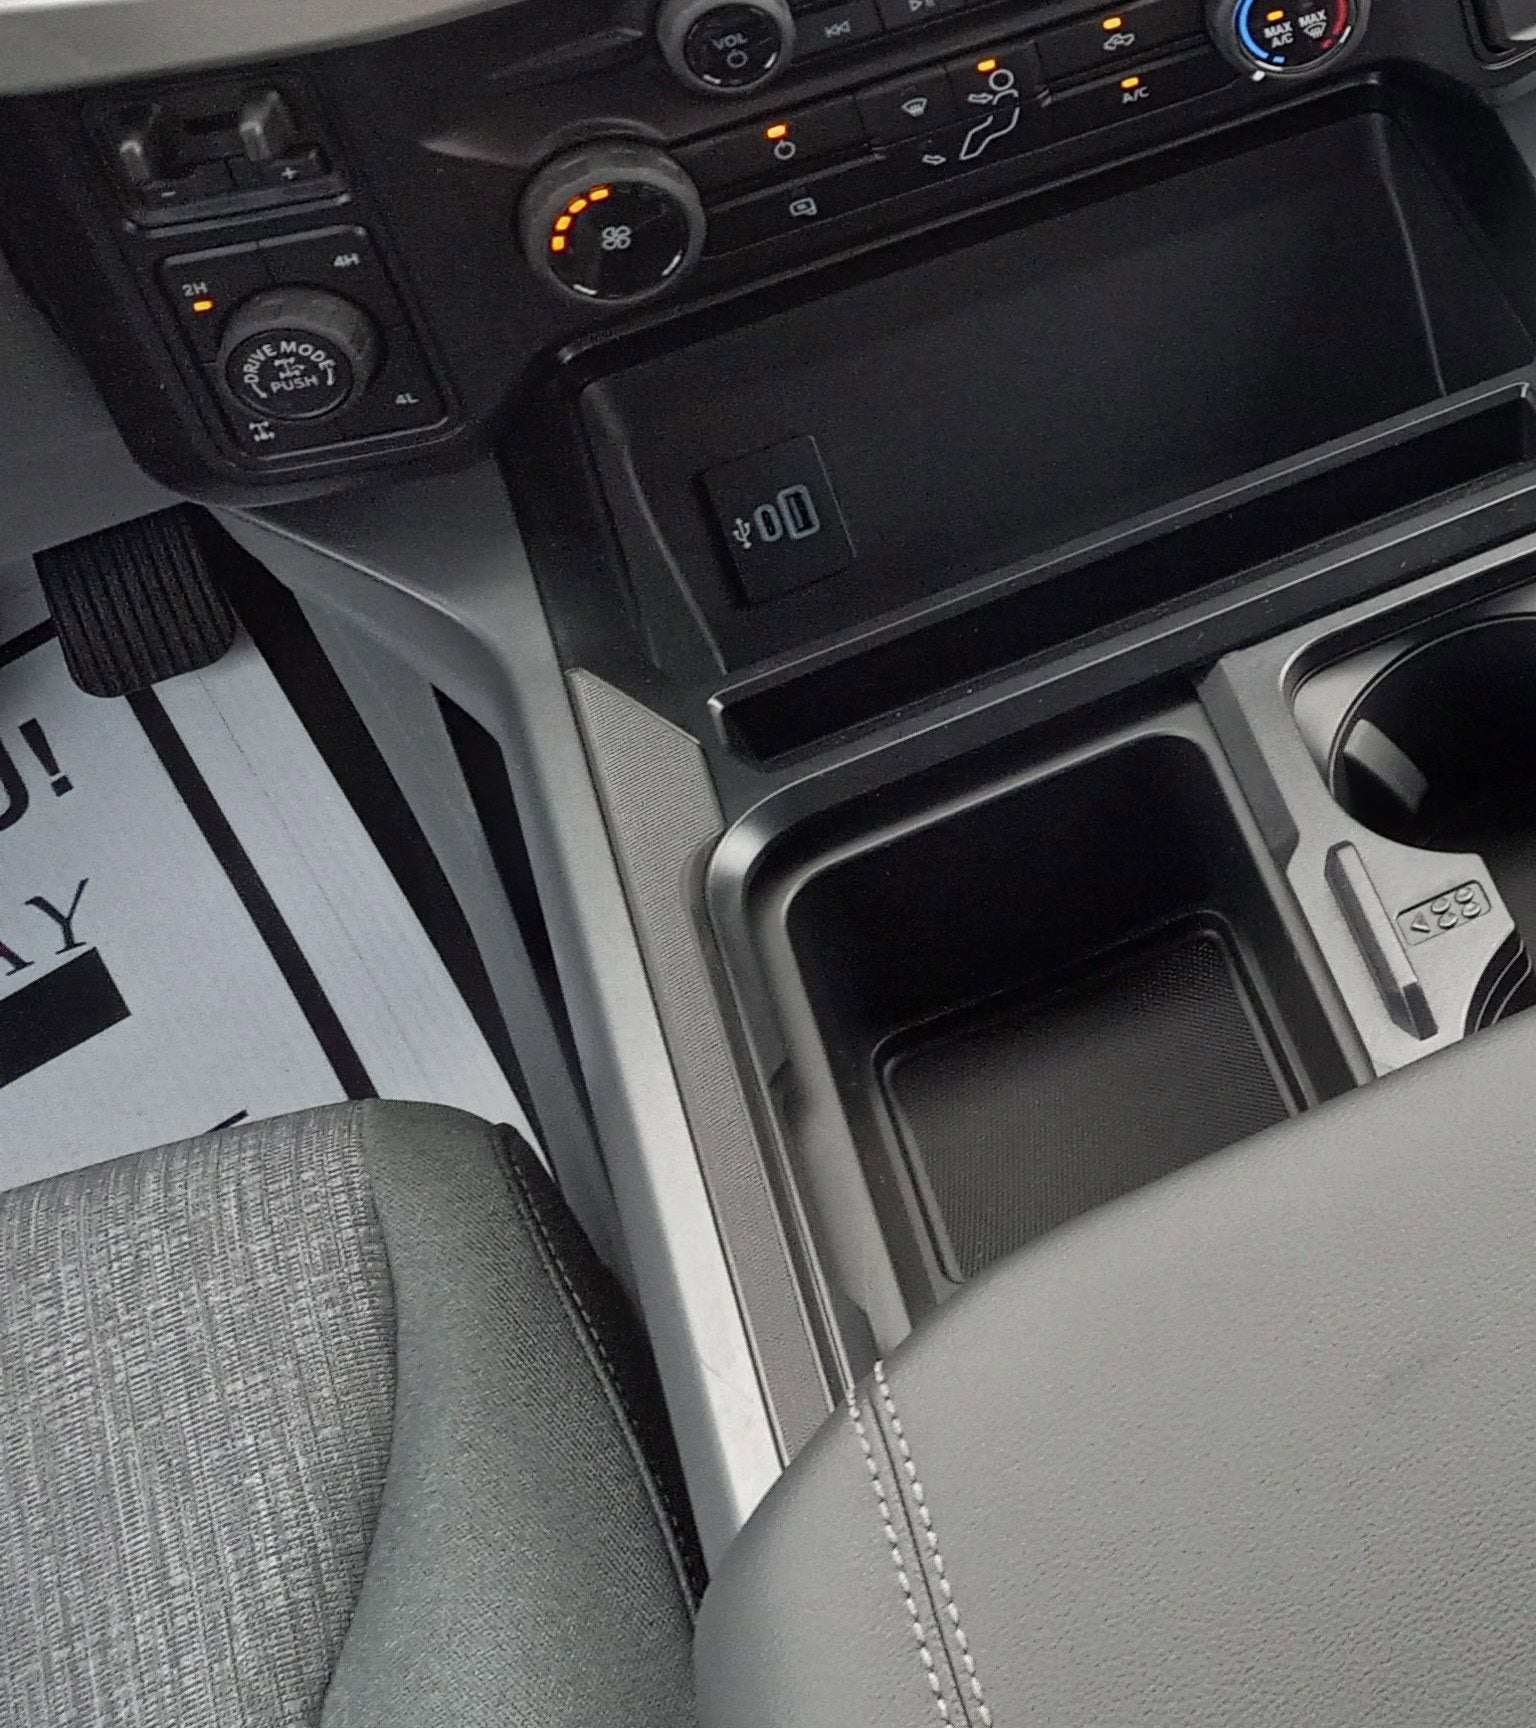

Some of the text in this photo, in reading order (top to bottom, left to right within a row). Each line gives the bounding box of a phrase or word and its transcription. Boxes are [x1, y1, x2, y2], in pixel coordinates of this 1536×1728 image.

[1298, 9, 1327, 28] MAX
[1263, 21, 1294, 39] MAX
[710, 33, 748, 50] VOL
[1271, 33, 1294, 49] A/C
[1122, 86, 1150, 104] A/C
[333, 252, 361, 269] 4H
[181, 281, 208, 297] 2H
[242, 340, 337, 384] DRIVE MODE
[270, 375, 319, 393] PUSH
[394, 391, 419, 406] 4L
